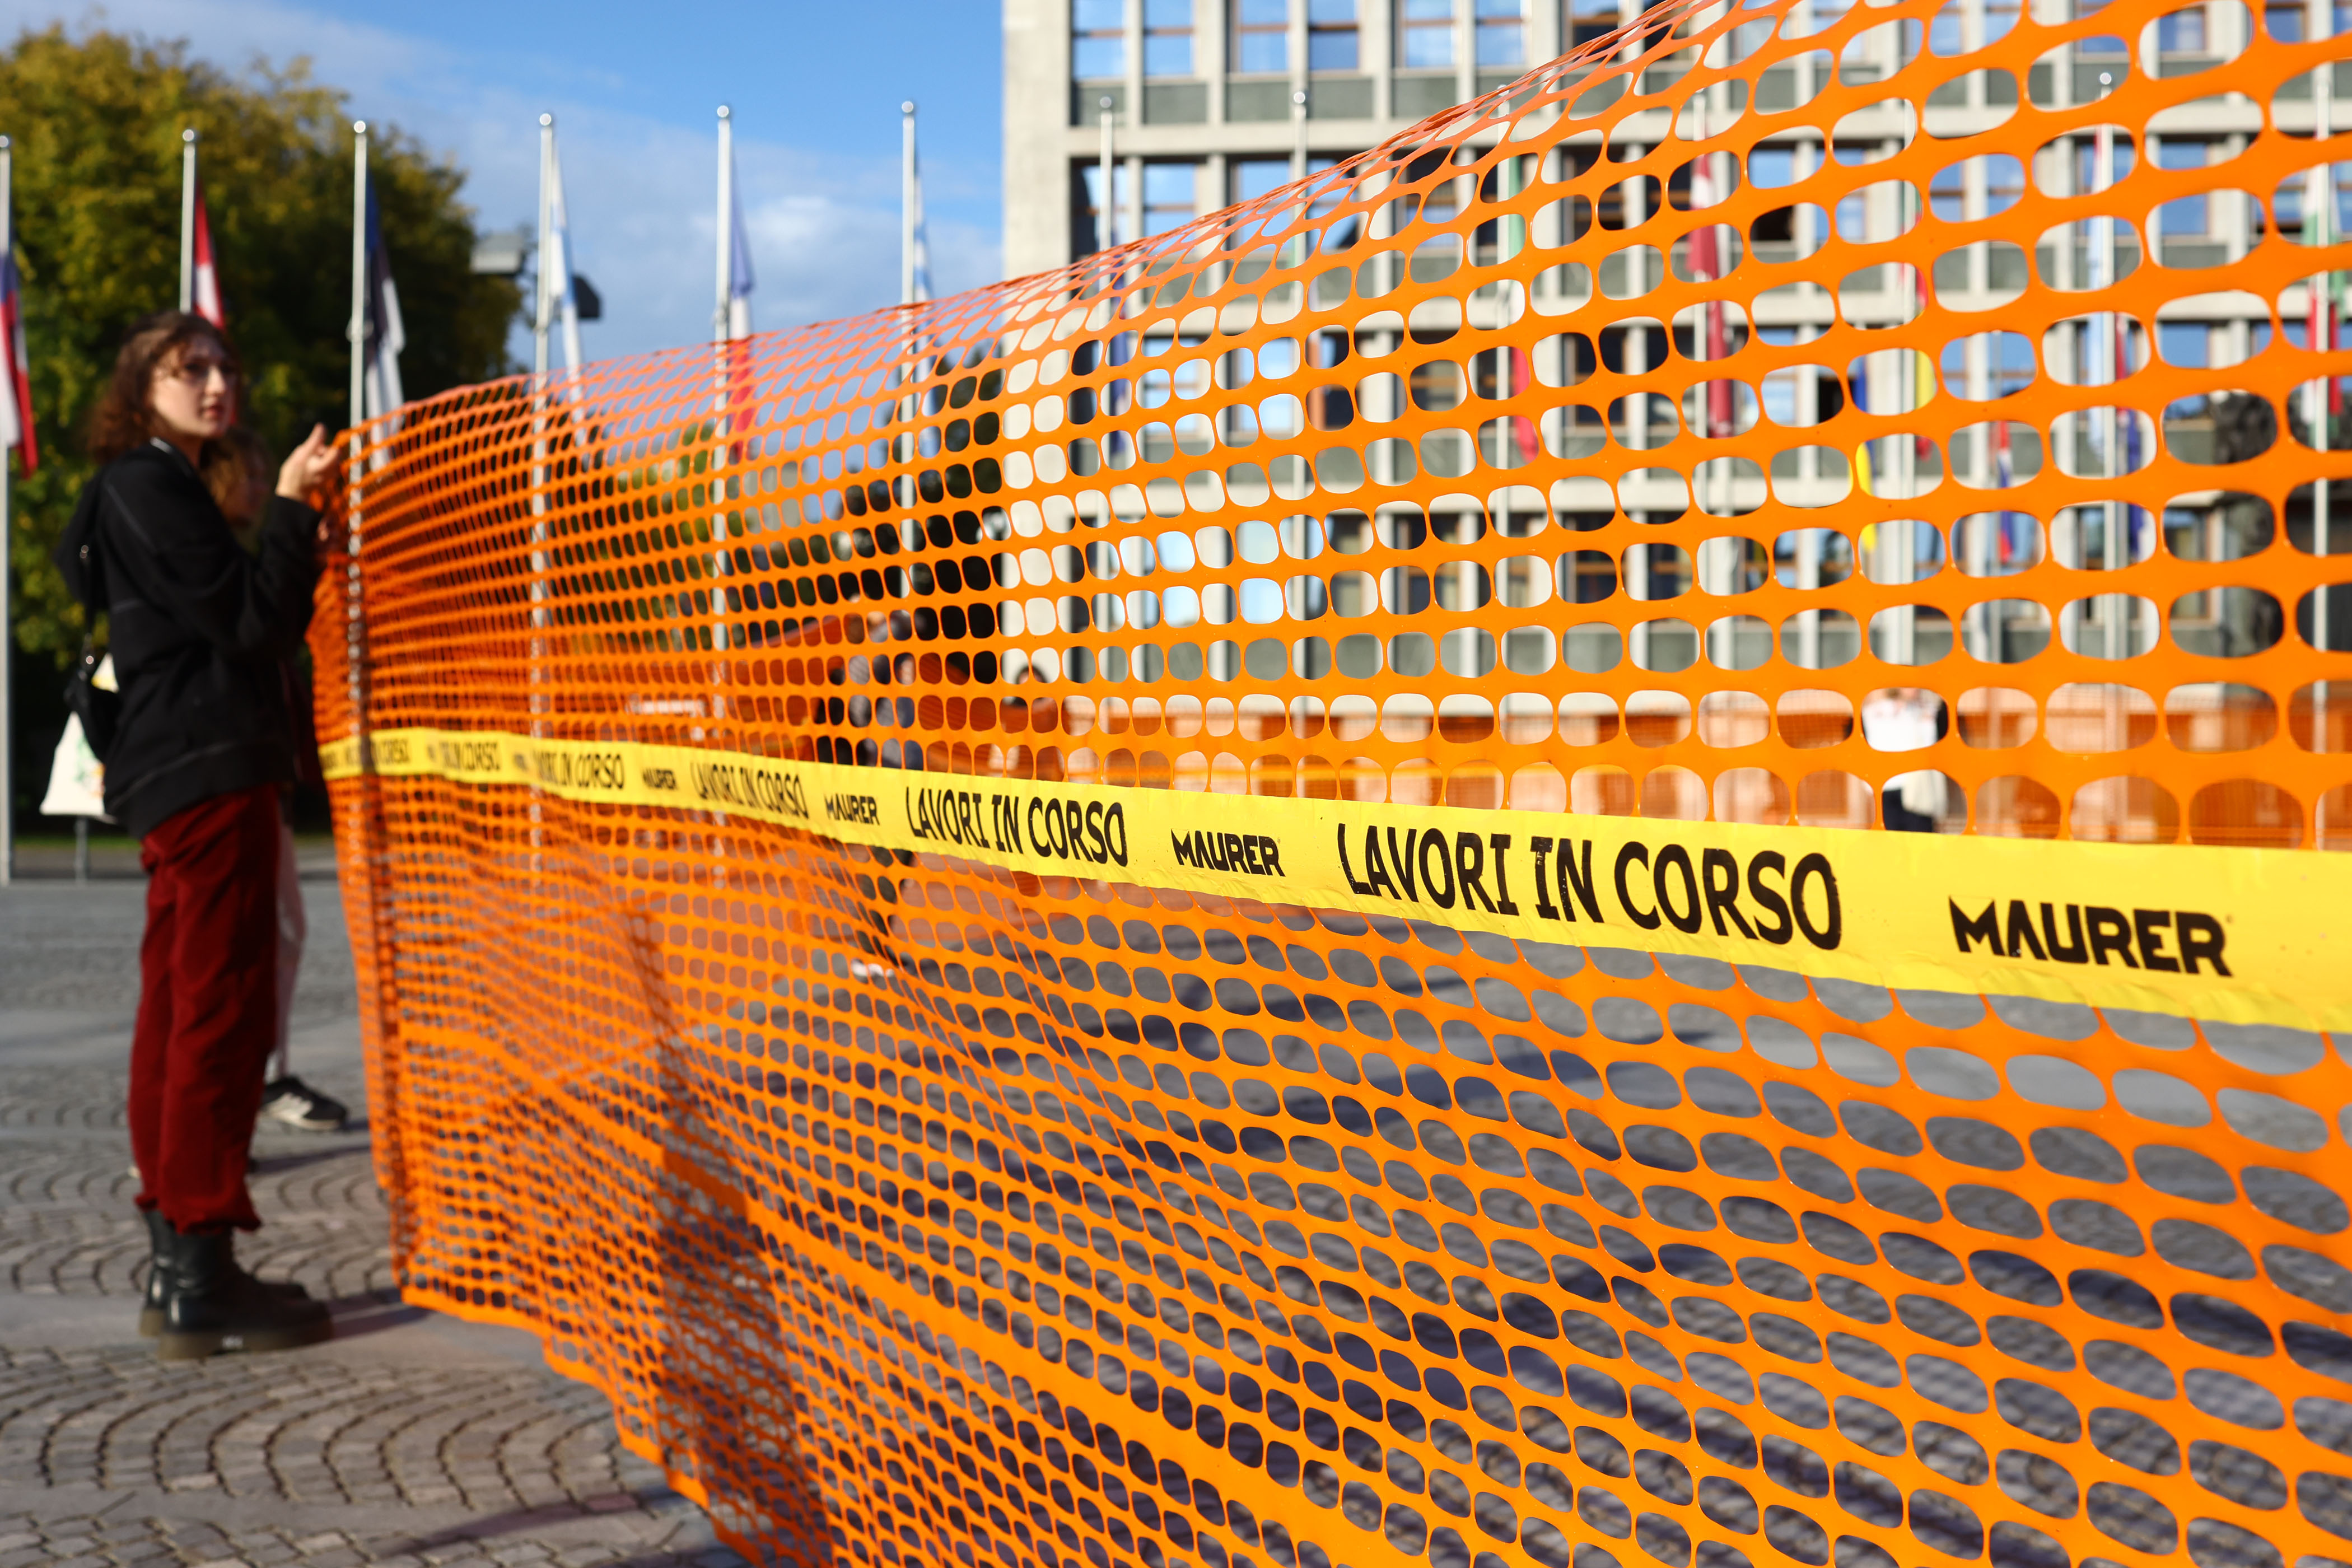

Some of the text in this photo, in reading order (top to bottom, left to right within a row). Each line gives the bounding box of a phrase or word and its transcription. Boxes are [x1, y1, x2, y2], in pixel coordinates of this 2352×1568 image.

[575, 754, 624, 789] CORSO
[690, 762, 809, 819] LAVORI IN CORSO
[824, 794, 879, 825] MAURER
[906, 787, 1128, 867] LAVORI IN CORSO
[1171, 828, 1285, 877] MAURER
[1337, 823, 1842, 950] LAVORI IN CORSO
[1948, 895, 2233, 977] MAURER
